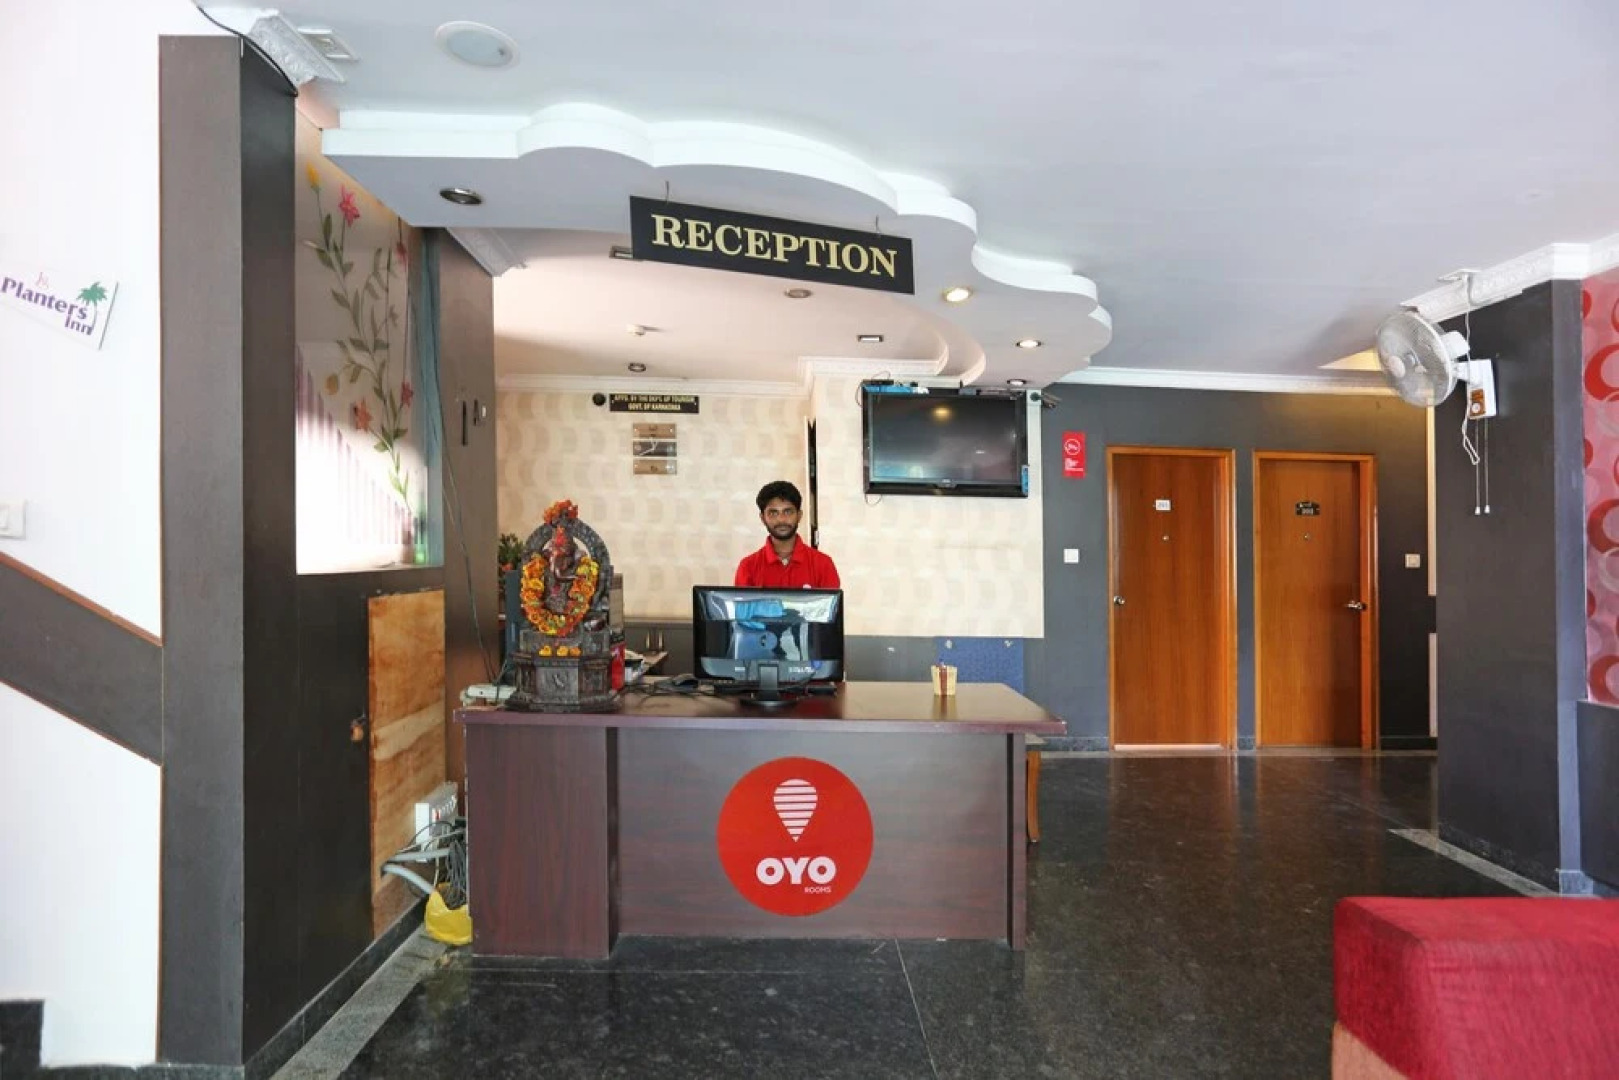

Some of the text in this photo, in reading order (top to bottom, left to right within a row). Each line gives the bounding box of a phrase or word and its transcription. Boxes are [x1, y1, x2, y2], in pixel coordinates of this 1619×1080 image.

[651, 213, 897, 278] RECEPTION
[1, 277, 88, 320] Planters
[64, 314, 94, 336] Inn
[755, 856, 837, 886] OYO
